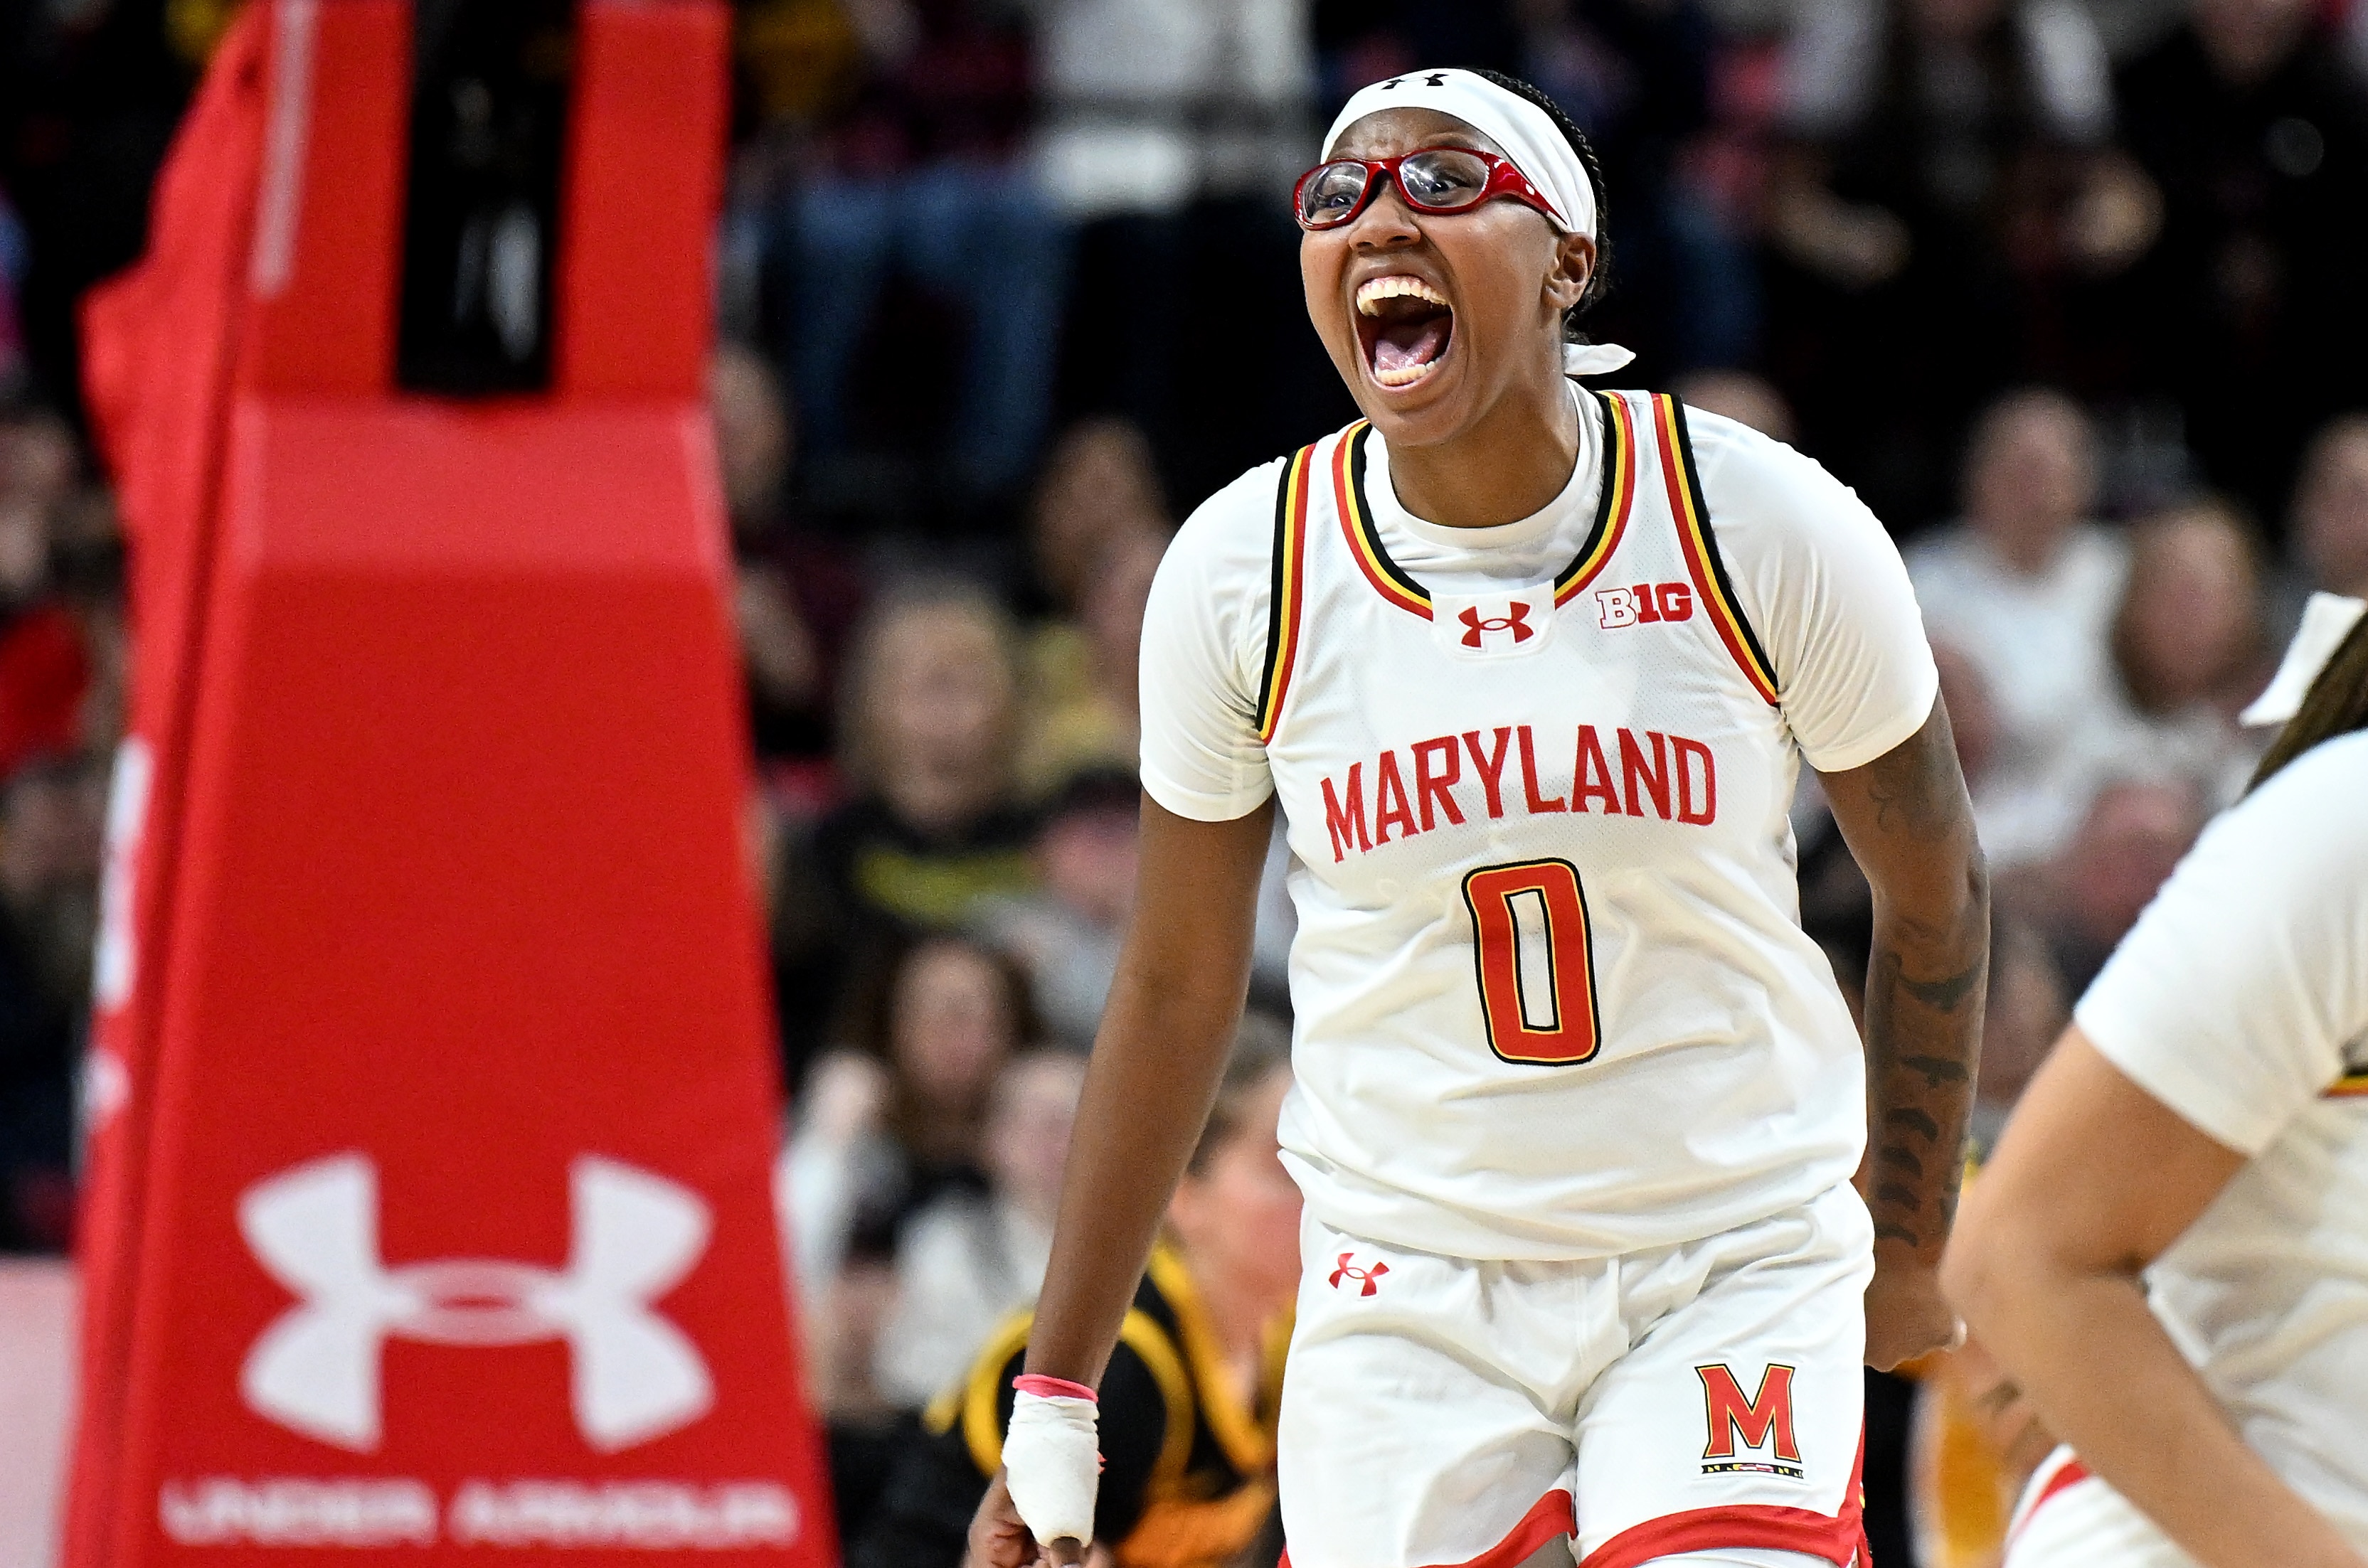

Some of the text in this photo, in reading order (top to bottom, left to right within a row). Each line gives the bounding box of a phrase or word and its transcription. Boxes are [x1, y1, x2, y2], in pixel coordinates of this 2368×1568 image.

[1321, 724, 1716, 863] MARYLAND
[1462, 857, 1600, 1067] 0
[1694, 1362, 1802, 1463] M
